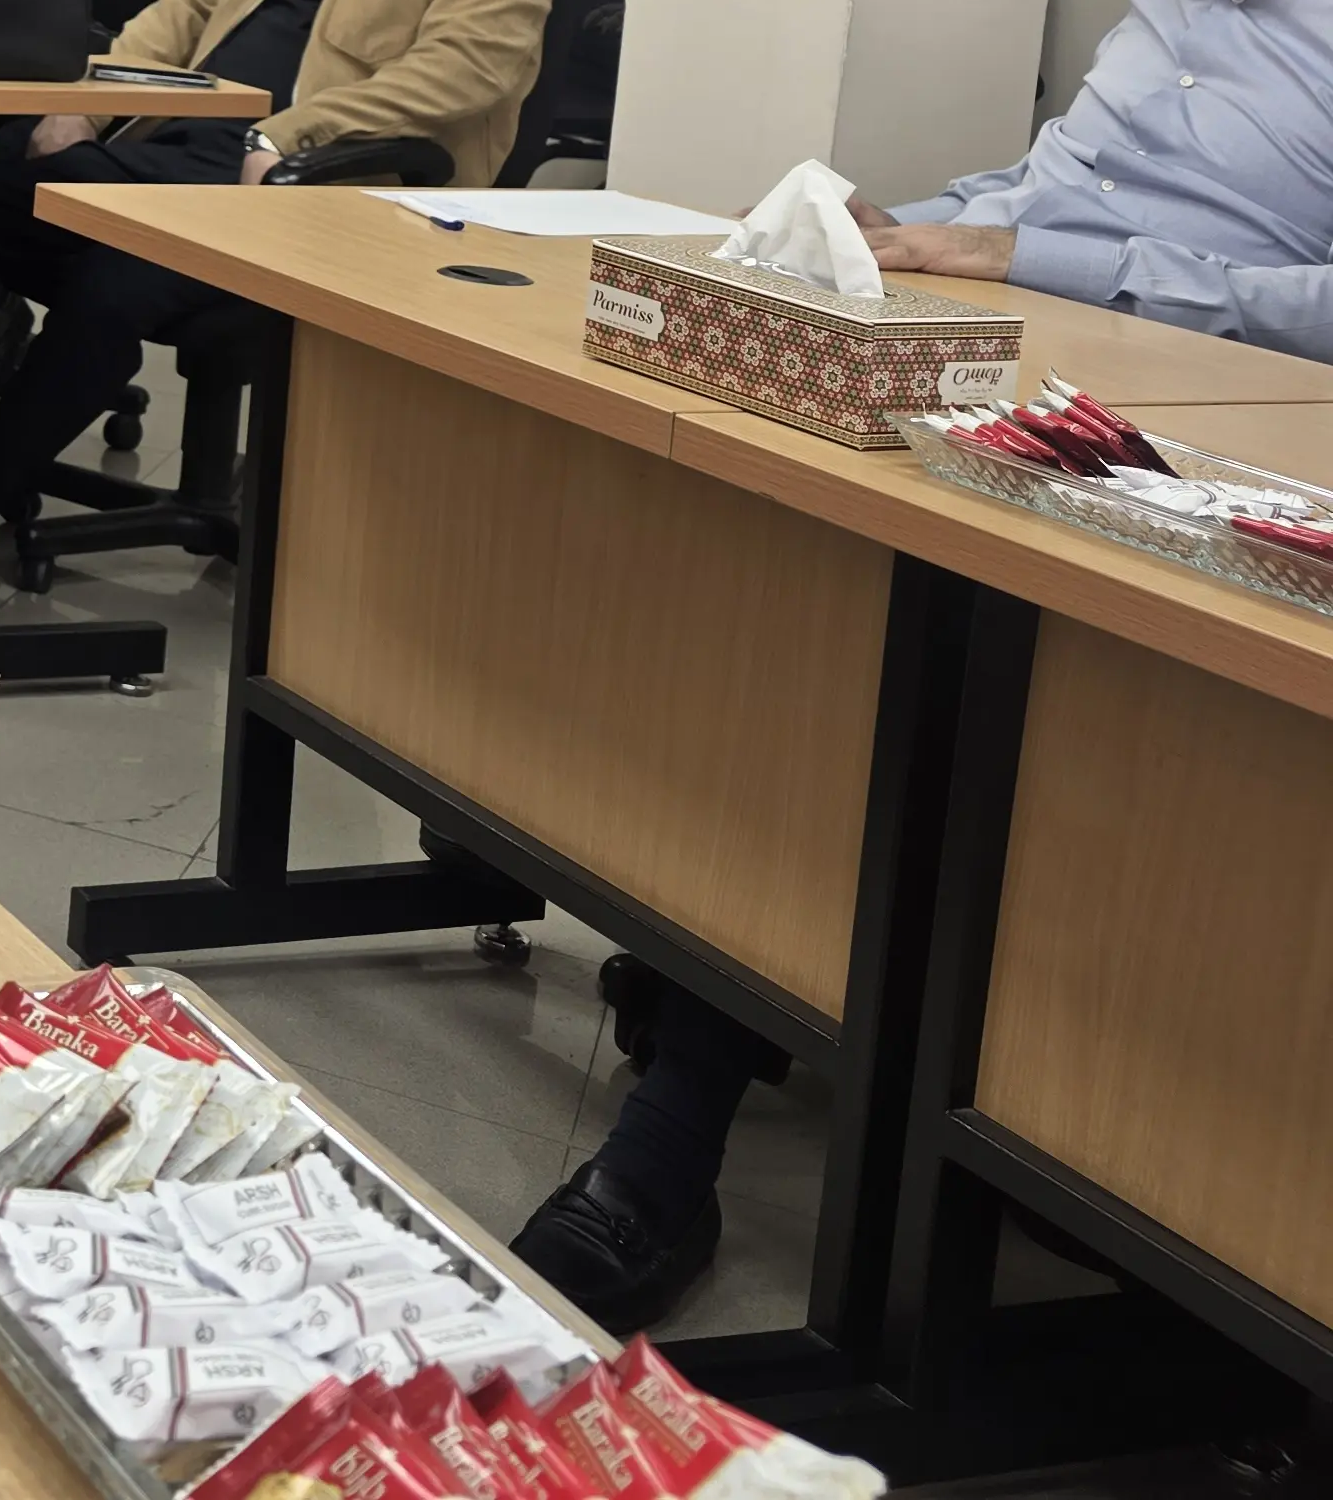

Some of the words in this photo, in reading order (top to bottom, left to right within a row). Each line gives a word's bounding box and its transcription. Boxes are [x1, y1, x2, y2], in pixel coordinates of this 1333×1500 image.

[592, 288, 655, 325] Parmiss
[22, 1007, 100, 1059] Baraka
[233, 1182, 283, 1207] ARSH
